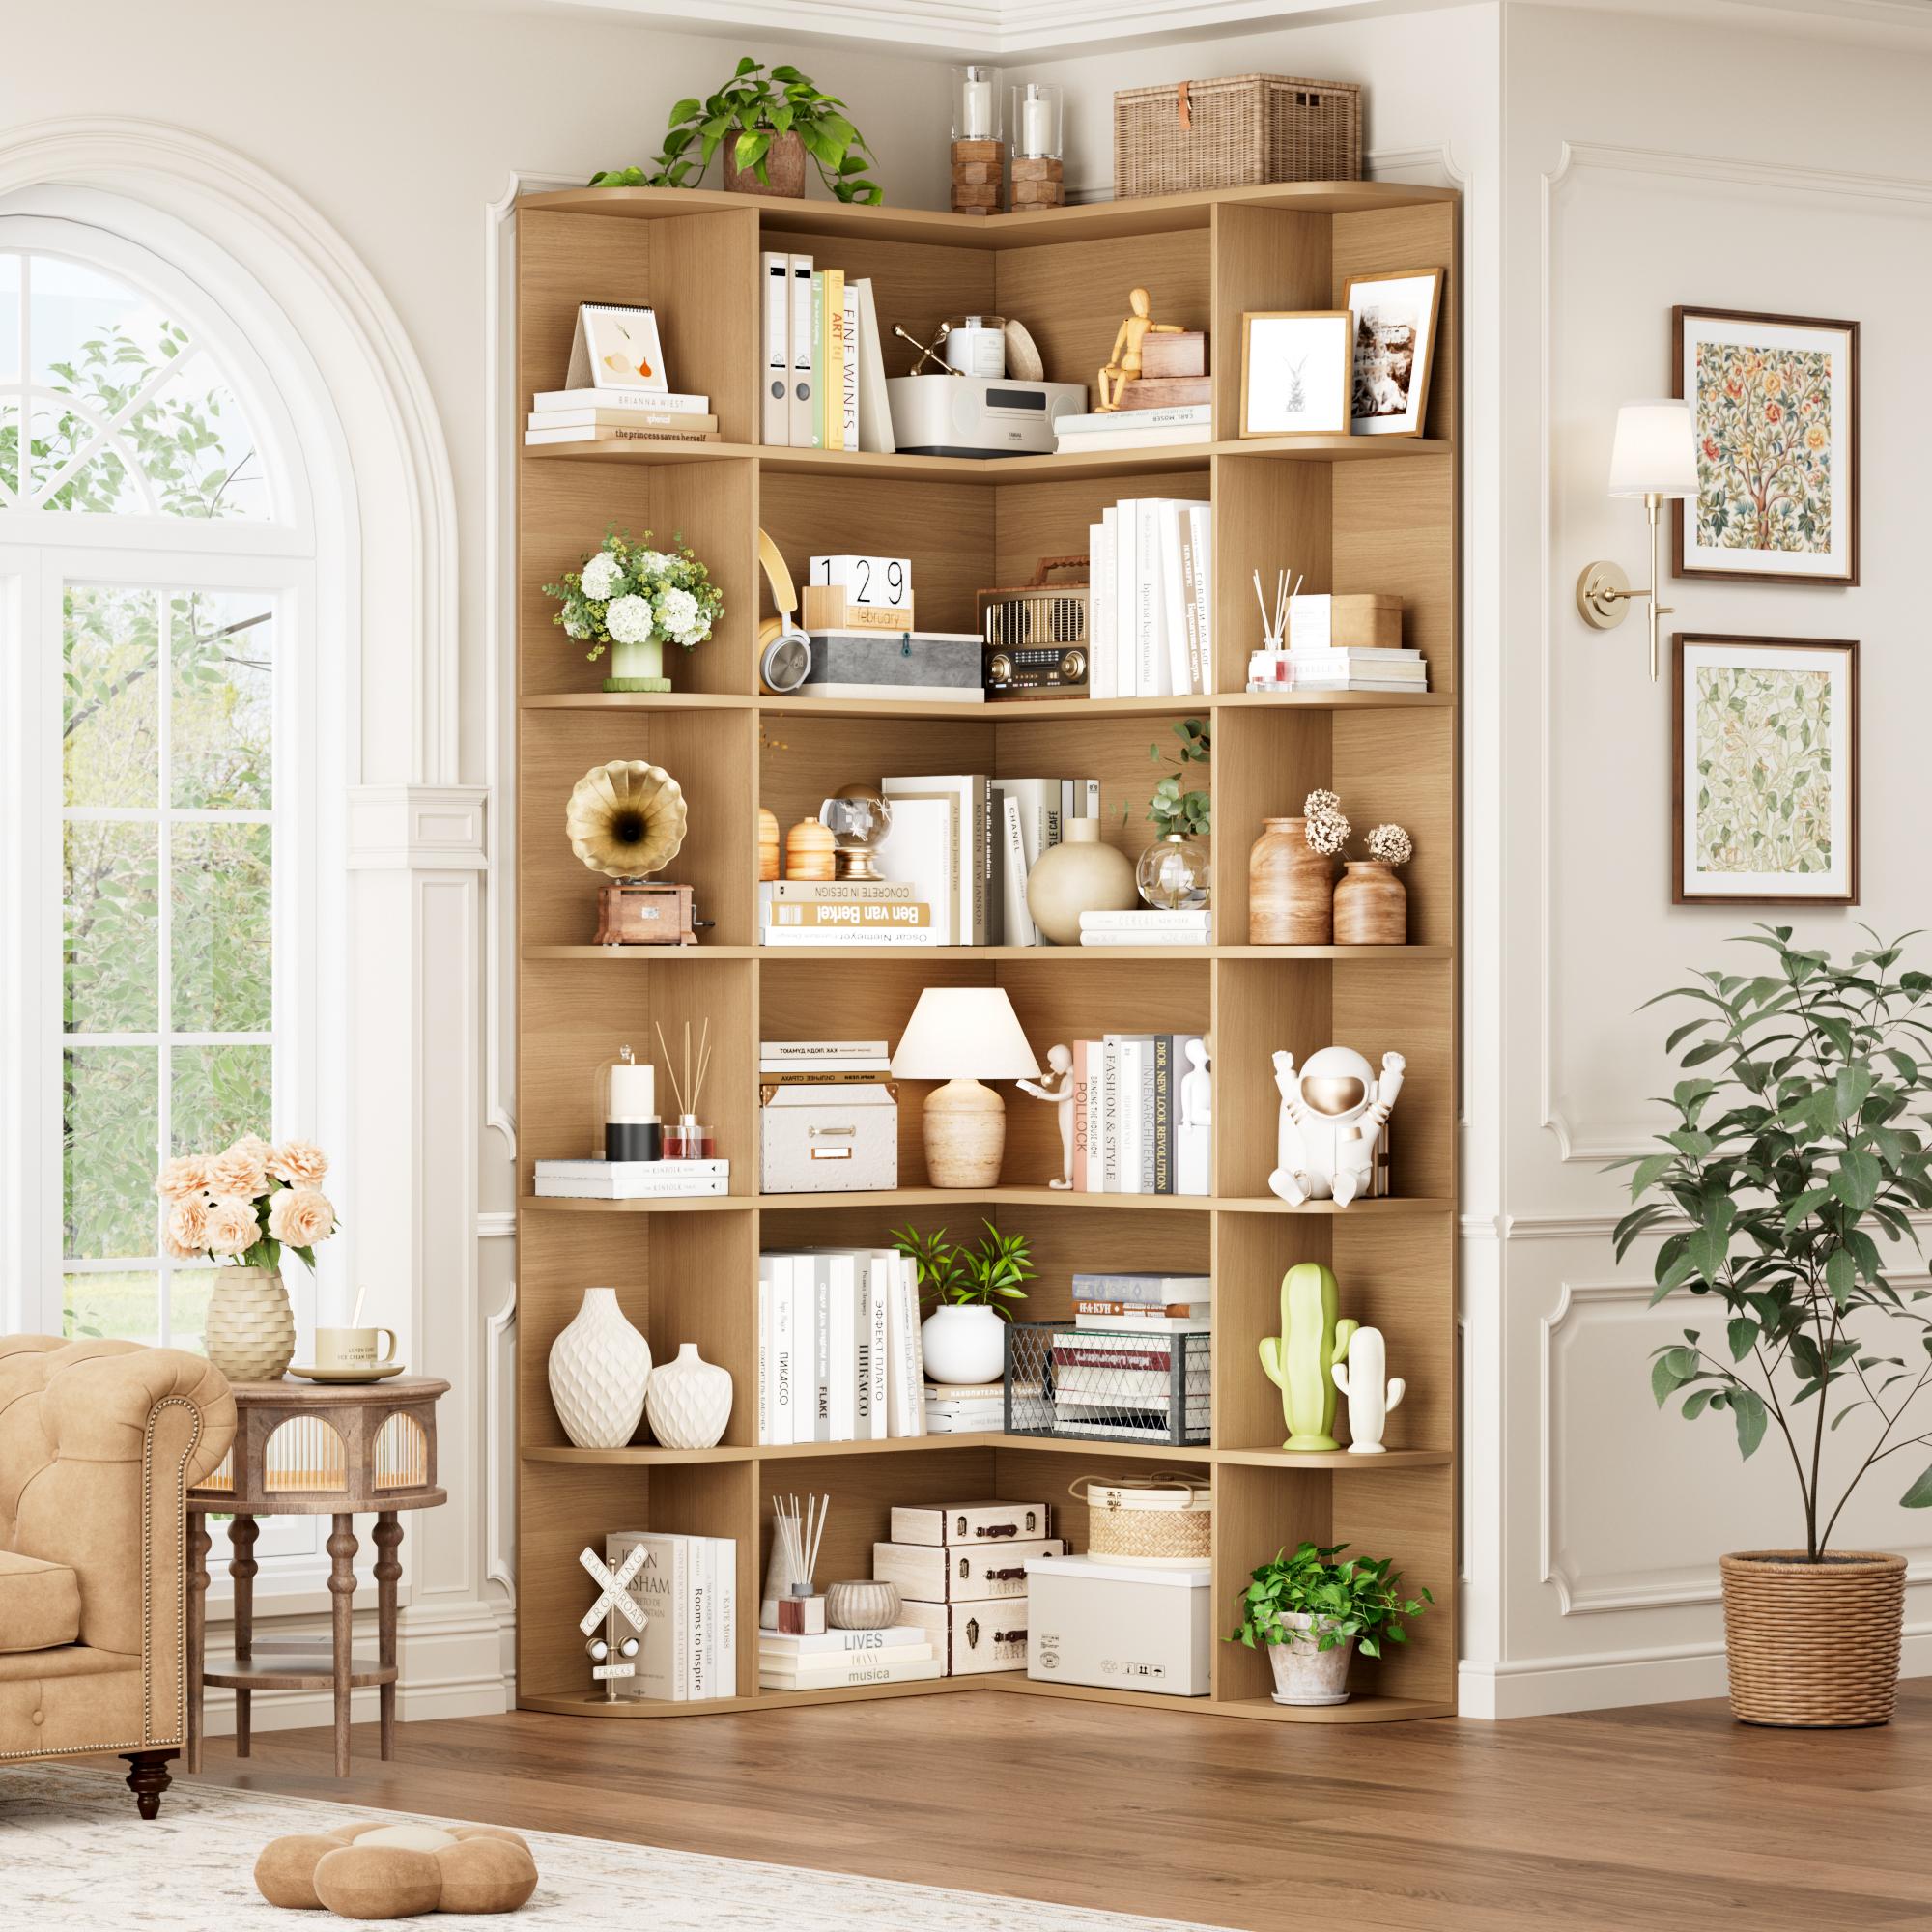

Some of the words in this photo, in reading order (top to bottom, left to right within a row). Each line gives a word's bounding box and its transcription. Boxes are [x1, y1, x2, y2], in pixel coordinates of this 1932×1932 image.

[832, 312, 842, 340] ART
[618, 395, 656, 406] BRIANNA
[660, 399, 685, 409] WIEST
[615, 428, 627, 438] the
[628, 430, 660, 440] princess
[681, 433, 707, 442] herself
[857, 607, 900, 628] february
[1009, 807, 1021, 853] CHANEL
[1048, 831, 1058, 840] LE
[814, 887, 848, 897] DESIGN
[850, 887, 860, 897] IN
[862, 887, 910, 898] CONCRETE
[816, 905, 861, 923] Berkel
[864, 906, 890, 920] van
[892, 906, 919, 923] Ben
[839, 933, 892, 942] Niemeyer
[895, 933, 928, 943] Oscar
[1106, 1055, 1116, 1118] FASHION
[1156, 1071, 1167, 1094] NEW
[1075, 1082, 1087, 1151] POLLOCK
[1156, 1096, 1167, 1123] LOOK
[1106, 1122, 1116, 1133] &
[1143, 1064, 1154, 1188] INNENARCHITEKTUR
[1106, 1136, 1116, 1180] STYLE
[1156, 1126, 1167, 1190] REVOLUTION
[875, 1300, 884, 1352] ЭФФЕКТ
[779, 1352, 789, 1406] ПИКАССО
[858, 1345, 869, 1417] ПИКАССО
[875, 1357, 884, 1401] ПЛАТО
[819, 1386, 828, 1419] FLAKE
[585, 1553, 609, 1584] RAIL
[586, 1553, 642, 1628] CROSSING
[988, 1581, 1024, 1595] PARIS
[618, 1594, 644, 1626] ROAD
[695, 1588, 703, 1630] Rooms
[695, 1633, 702, 1645] to
[844, 1633, 883, 1651] LIVES
[994, 1643, 1026, 1661] PARI
[692, 1649, 704, 1691] Inspire
[848, 1668, 890, 1682] musica
